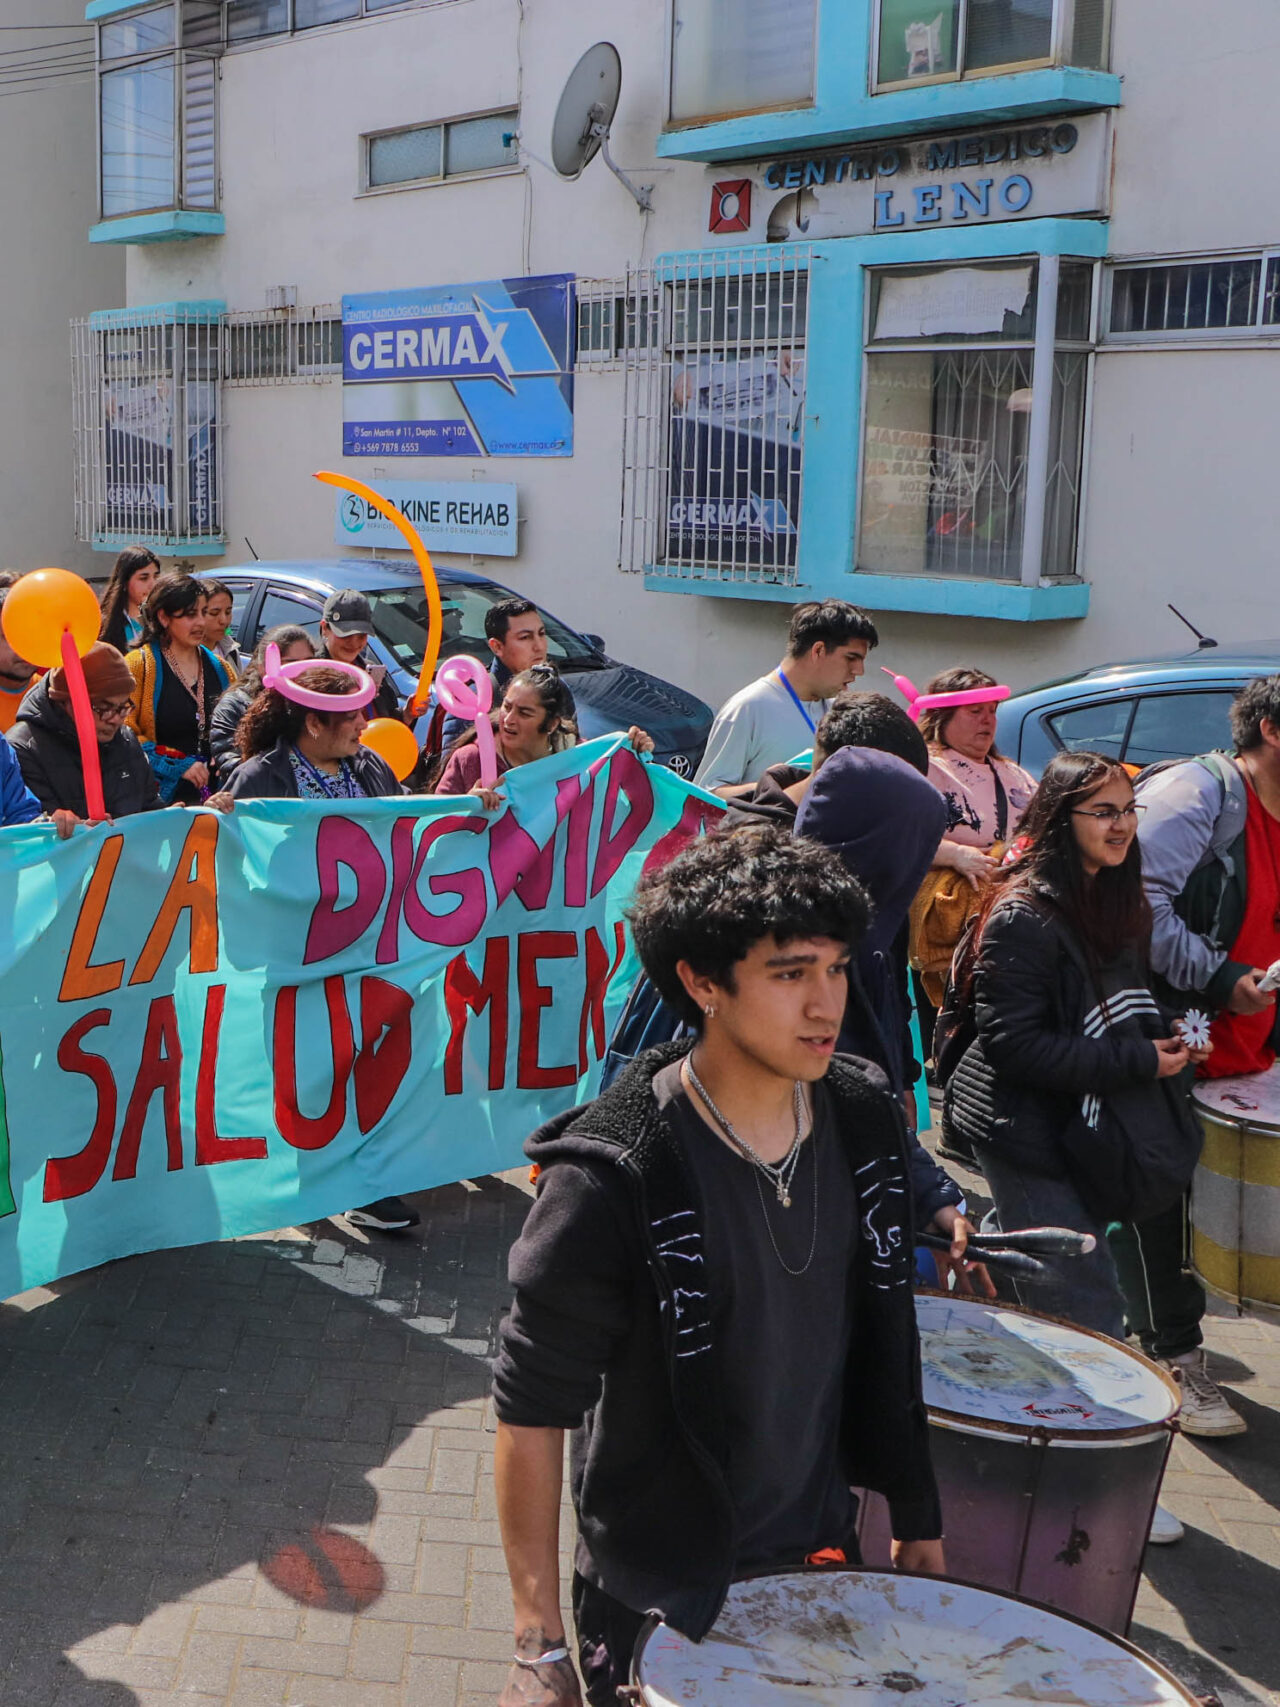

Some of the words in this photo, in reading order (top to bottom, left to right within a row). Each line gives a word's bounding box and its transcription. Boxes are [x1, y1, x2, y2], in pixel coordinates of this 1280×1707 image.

[764, 151, 901, 190] CENTRO
[927, 122, 1079, 171] MEDICO
[874, 174, 1032, 227] LENO
[345, 309, 372, 322] CENTRO
[349, 323, 515, 372] CERMAX
[360, 427, 372, 437] San
[415, 426, 438, 438] Depto.
[453, 426, 467, 437] 102
[361, 442, 380, 453] +569
[381, 442, 399, 453] 7878
[401, 442, 420, 453] 6553
[401, 499, 441, 524] KINE
[446, 501, 510, 527] REHAB
[671, 502, 770, 529] CERMAX
[58, 814, 219, 1003] LA
[43, 976, 415, 1203] SALUD
